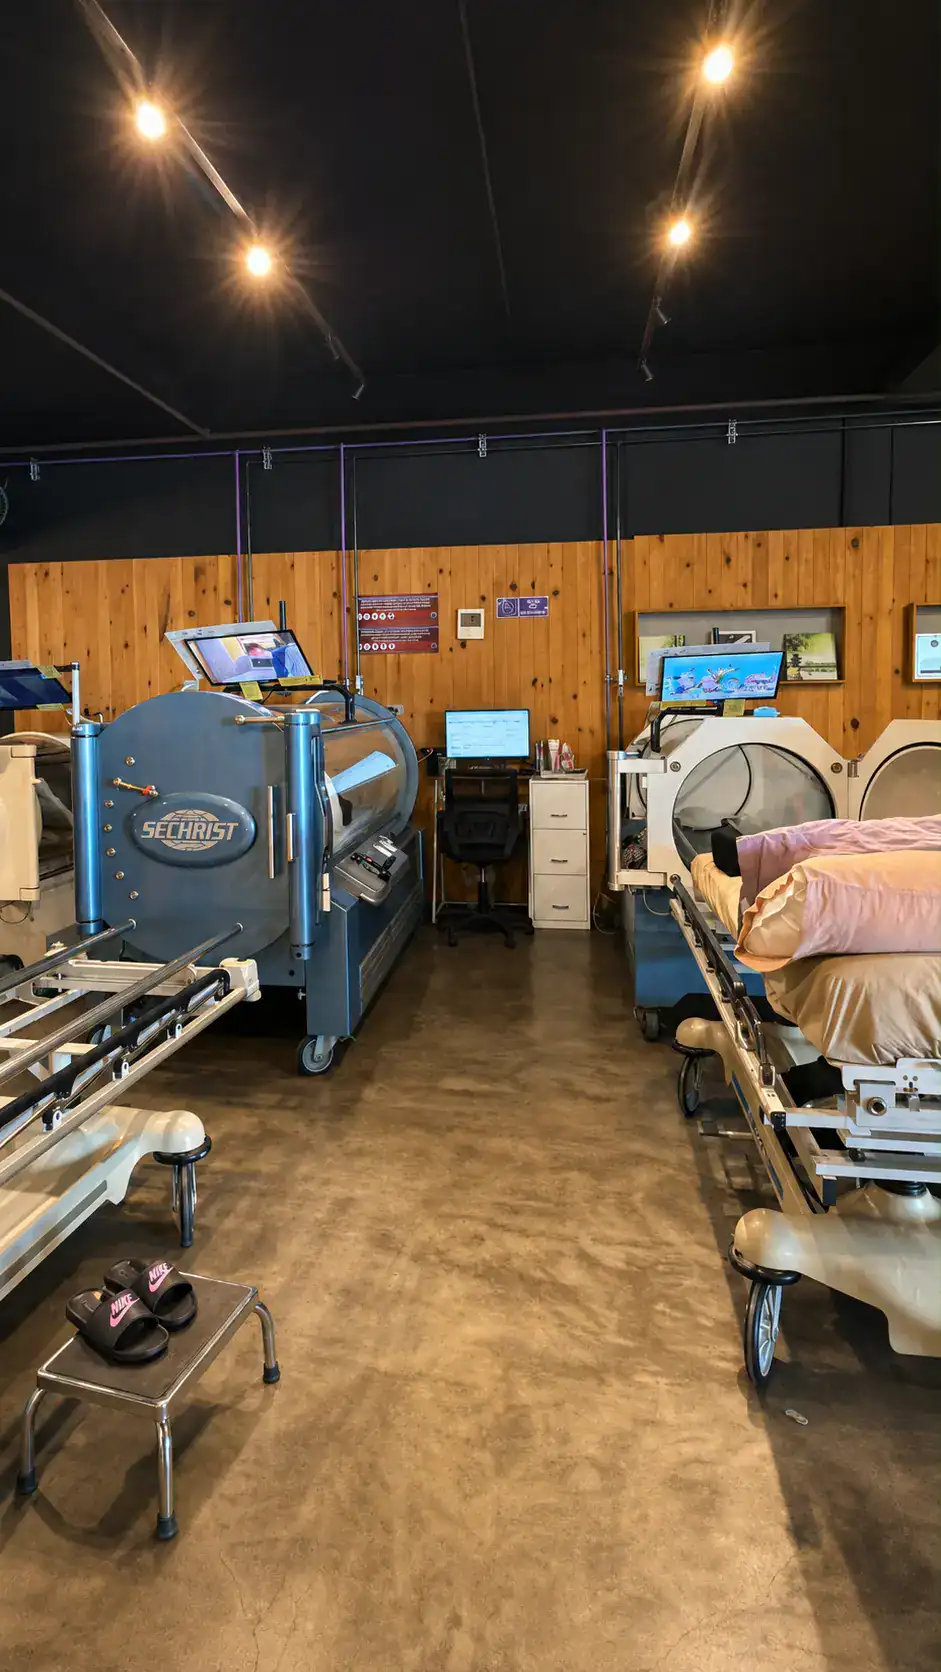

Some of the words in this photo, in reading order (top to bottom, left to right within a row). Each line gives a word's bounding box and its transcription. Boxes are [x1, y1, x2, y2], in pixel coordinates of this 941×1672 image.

[141, 821, 239, 840] SECHRIST
[148, 1262, 169, 1281] NIKE
[110, 1293, 133, 1316] NIKE
